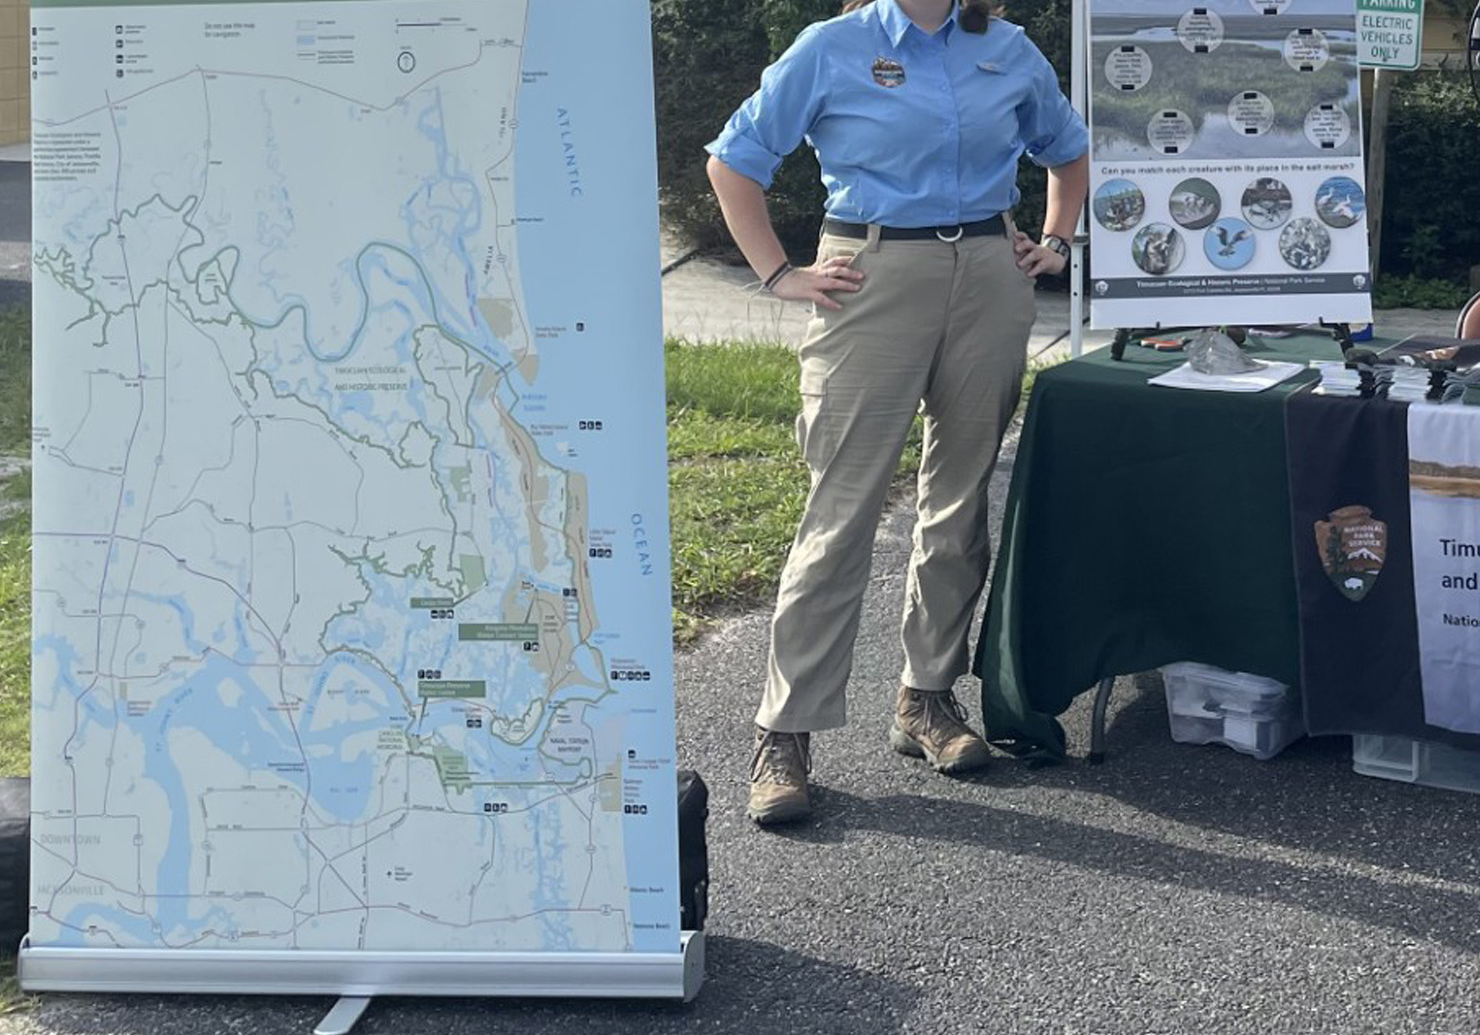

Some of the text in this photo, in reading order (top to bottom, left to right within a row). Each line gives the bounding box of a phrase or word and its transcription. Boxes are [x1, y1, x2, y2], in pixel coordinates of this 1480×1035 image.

[1362, 15, 1413, 30] ELECTRIC
[1361, 30, 1413, 45] VEHICLES
[1371, 45, 1400, 59] ONLY
[557, 106, 583, 198] ATLANTIC
[1101, 167, 1119, 175] Can
[1138, 166, 1164, 174] match
[1225, 164, 1243, 172] with
[1256, 164, 1279, 173] place
[1291, 163, 1304, 171] the
[1343, 525, 1383, 533] NATIONAL
[631, 513, 654, 576] OCEAN
[1441, 571, 1479, 592] and
